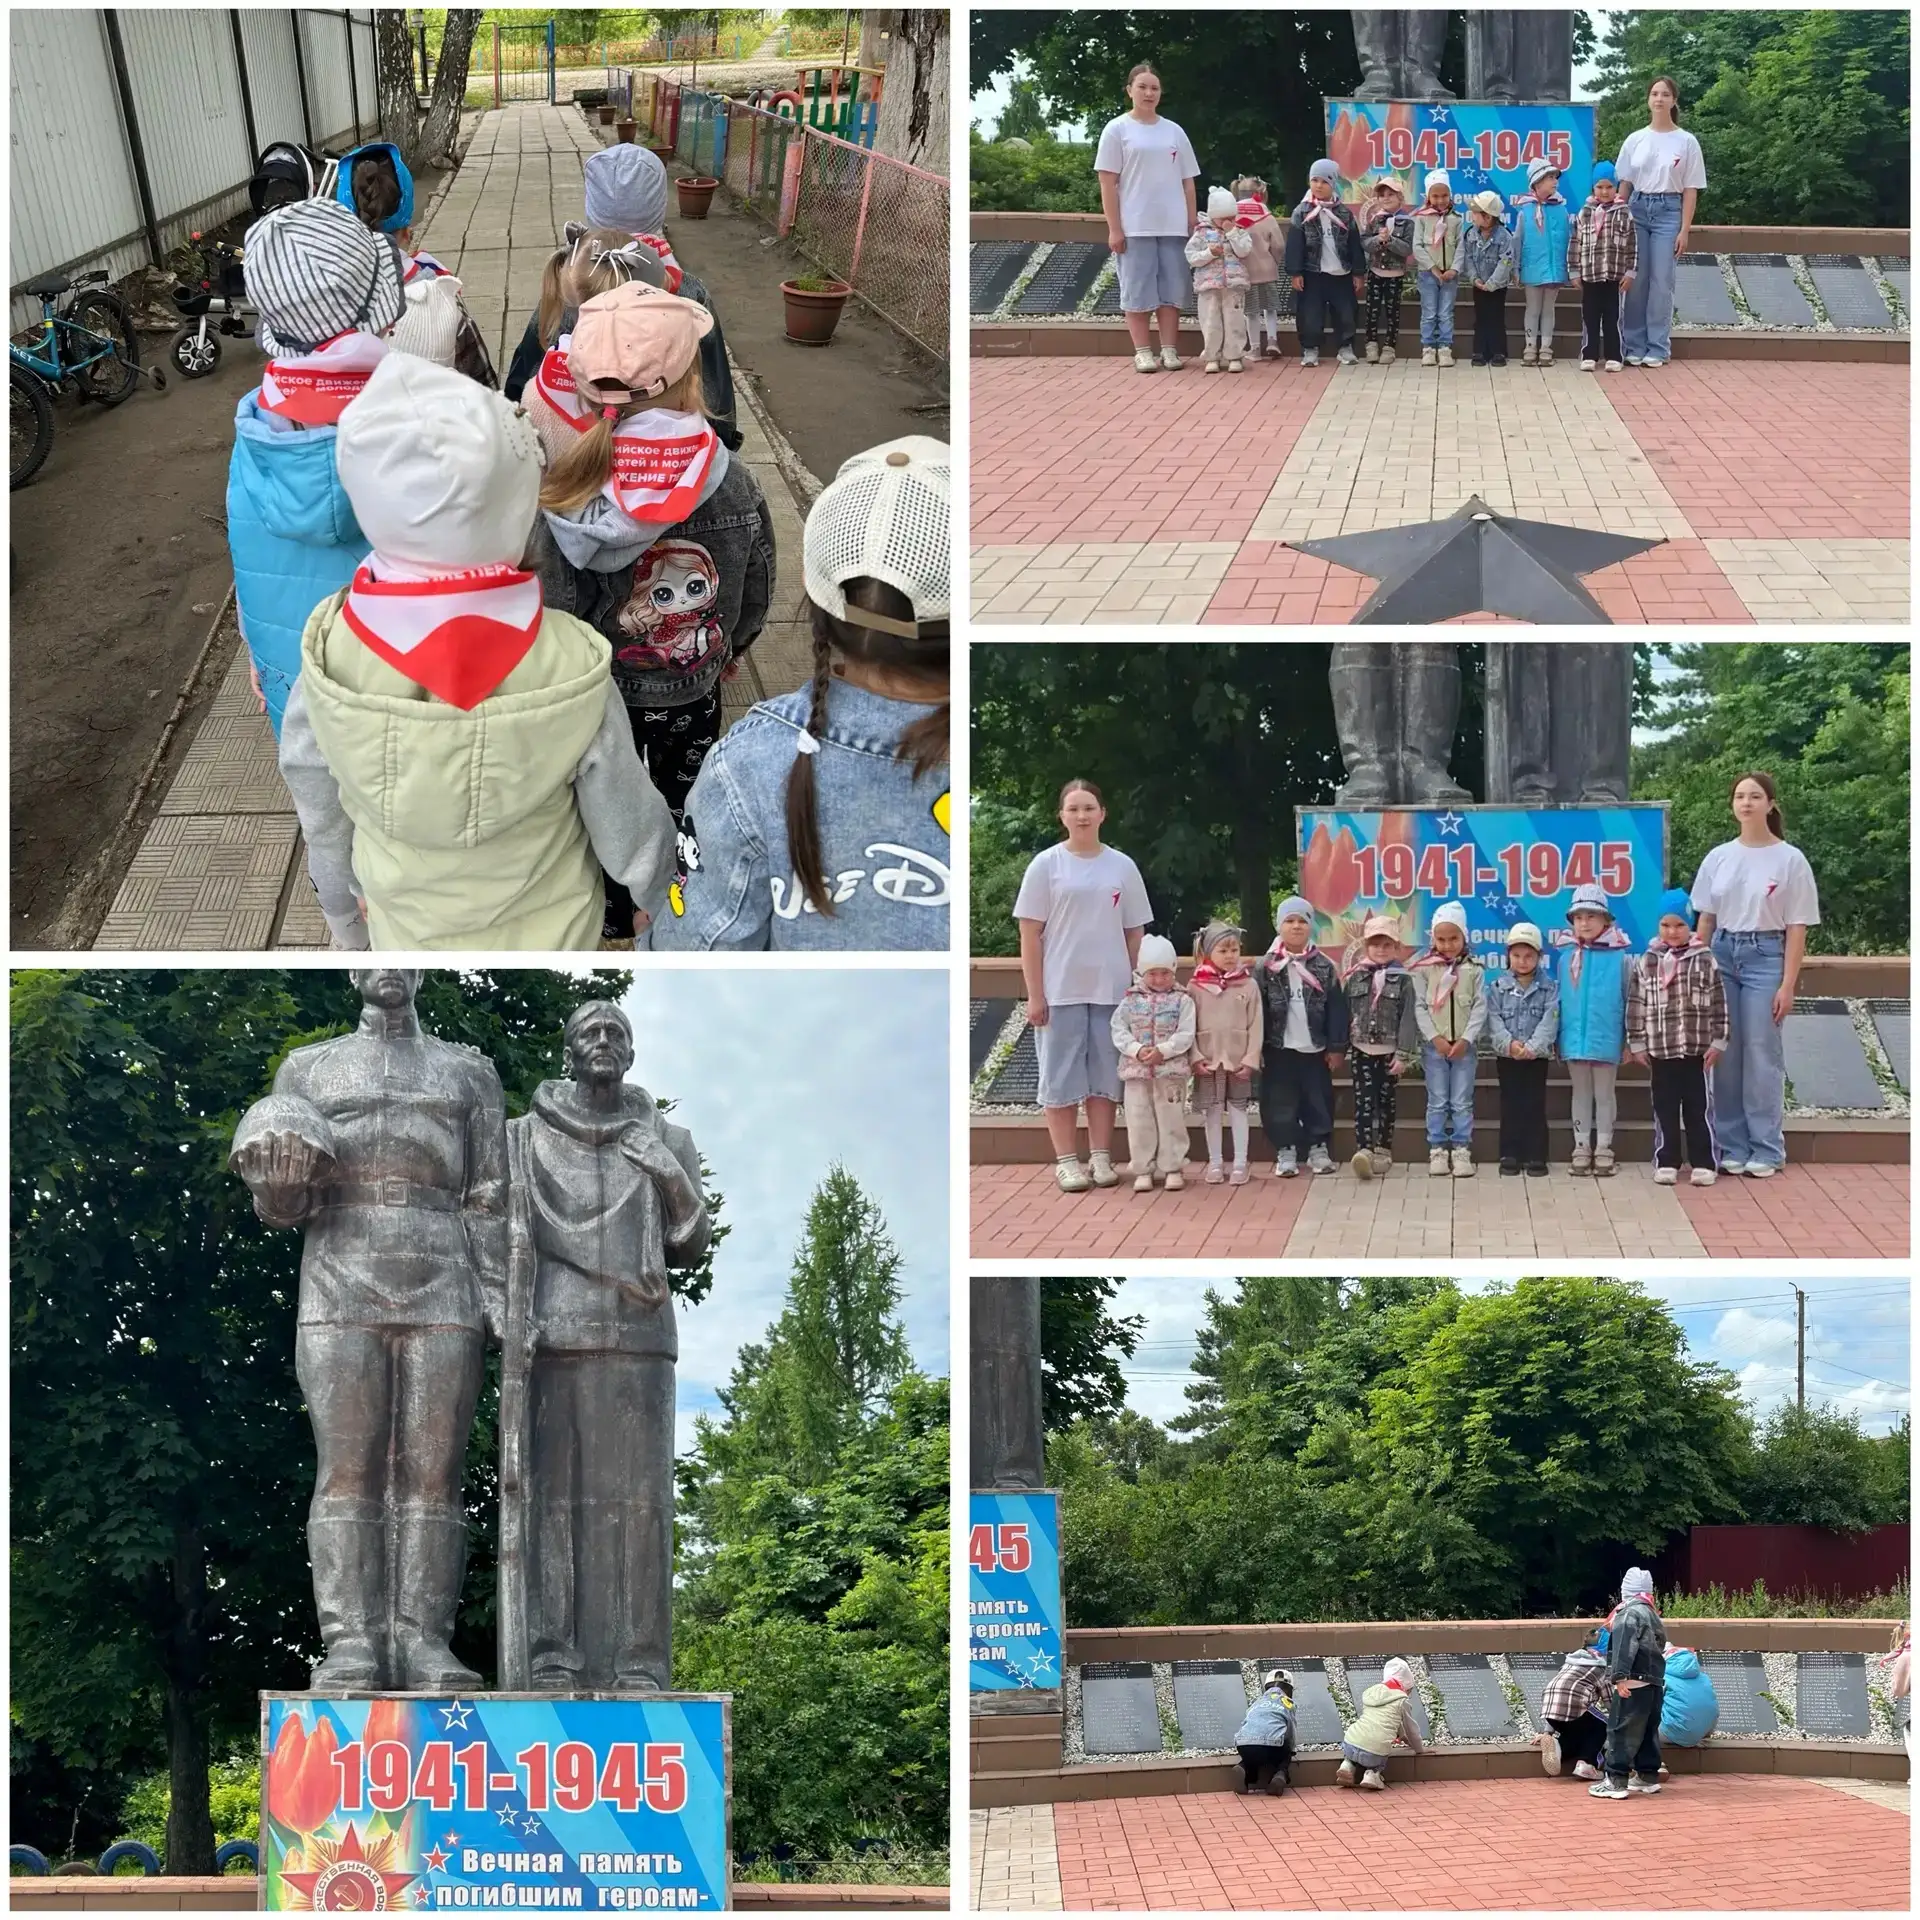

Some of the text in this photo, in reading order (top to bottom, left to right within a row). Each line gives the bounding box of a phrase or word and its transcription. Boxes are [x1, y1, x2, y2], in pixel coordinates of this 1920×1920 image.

[1366, 128, 1572, 172] 1941-1945
[315, 385, 364, 393] молод
[1352, 841, 1634, 899] 1941-1945
[330, 1740, 688, 1814] 1941-1945
[462, 1849, 683, 1875] Вечная память
[436, 1882, 710, 1911] погибшим героям-
